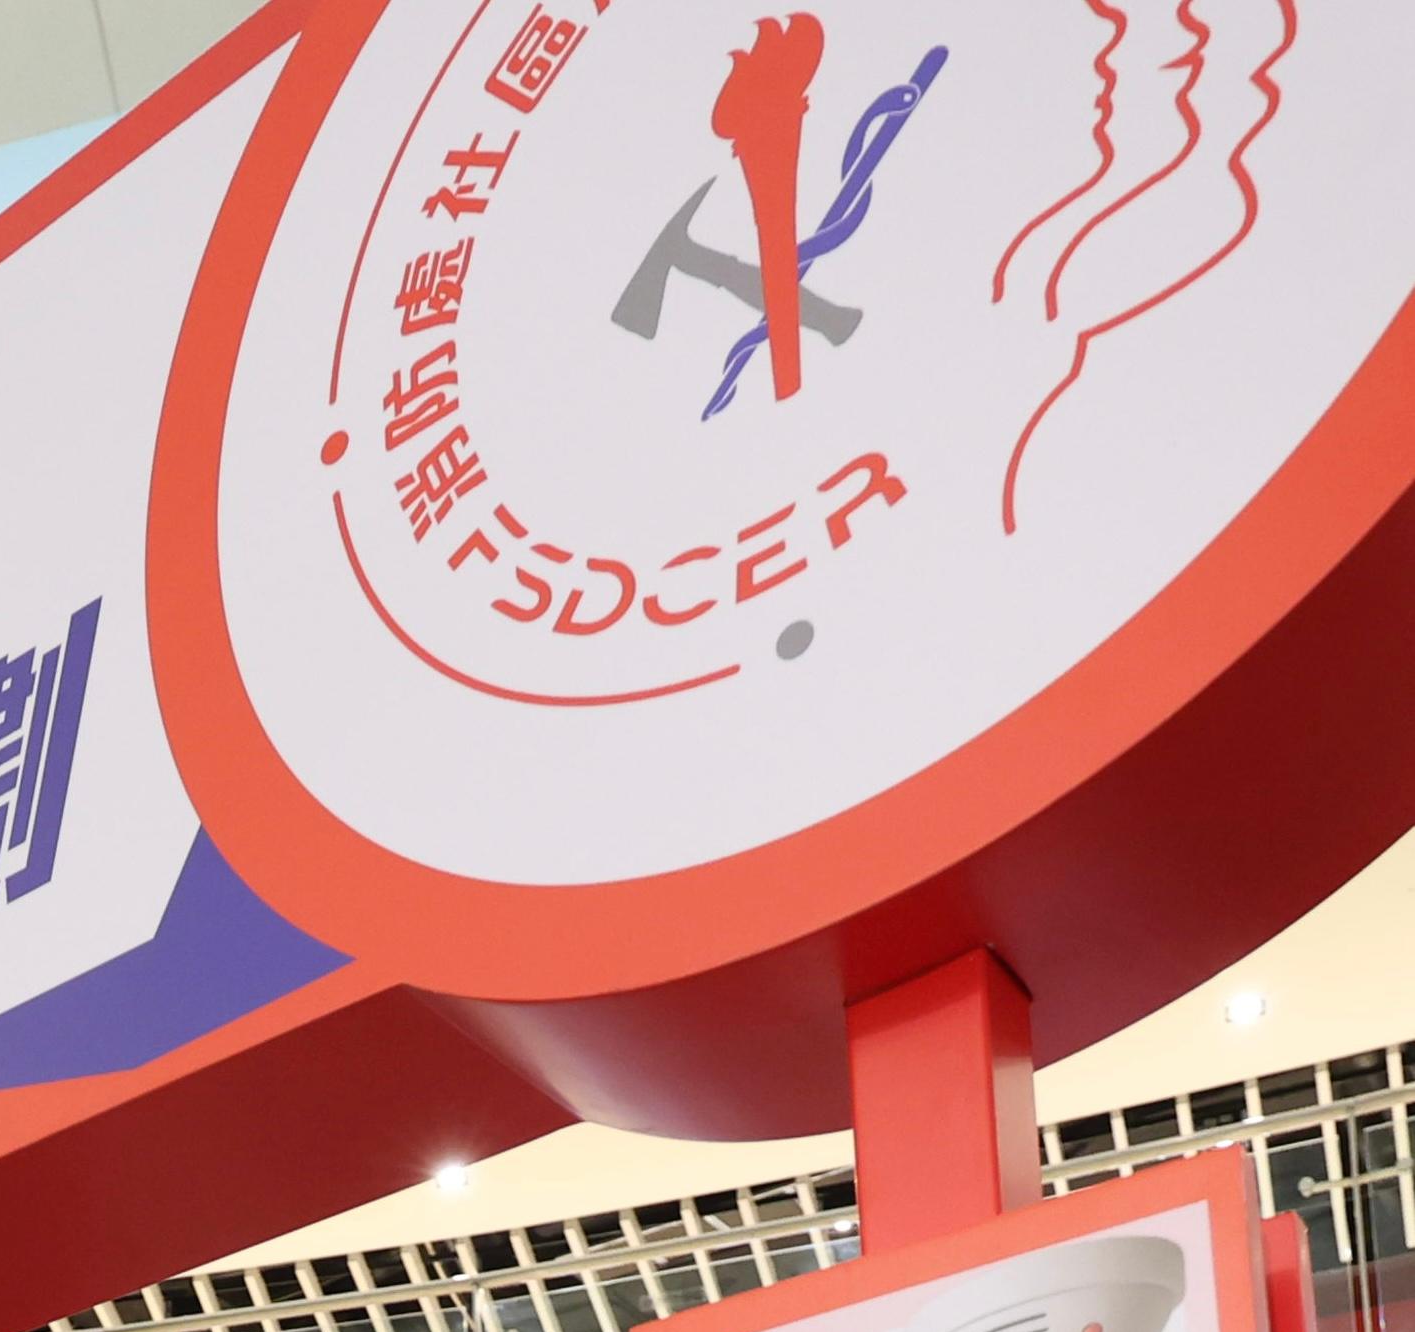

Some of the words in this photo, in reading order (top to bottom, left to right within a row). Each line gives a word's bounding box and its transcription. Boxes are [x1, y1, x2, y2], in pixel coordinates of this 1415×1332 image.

[382, 0, 609, 543] 消防處社區
[447, 451, 908, 636] FSDCER
